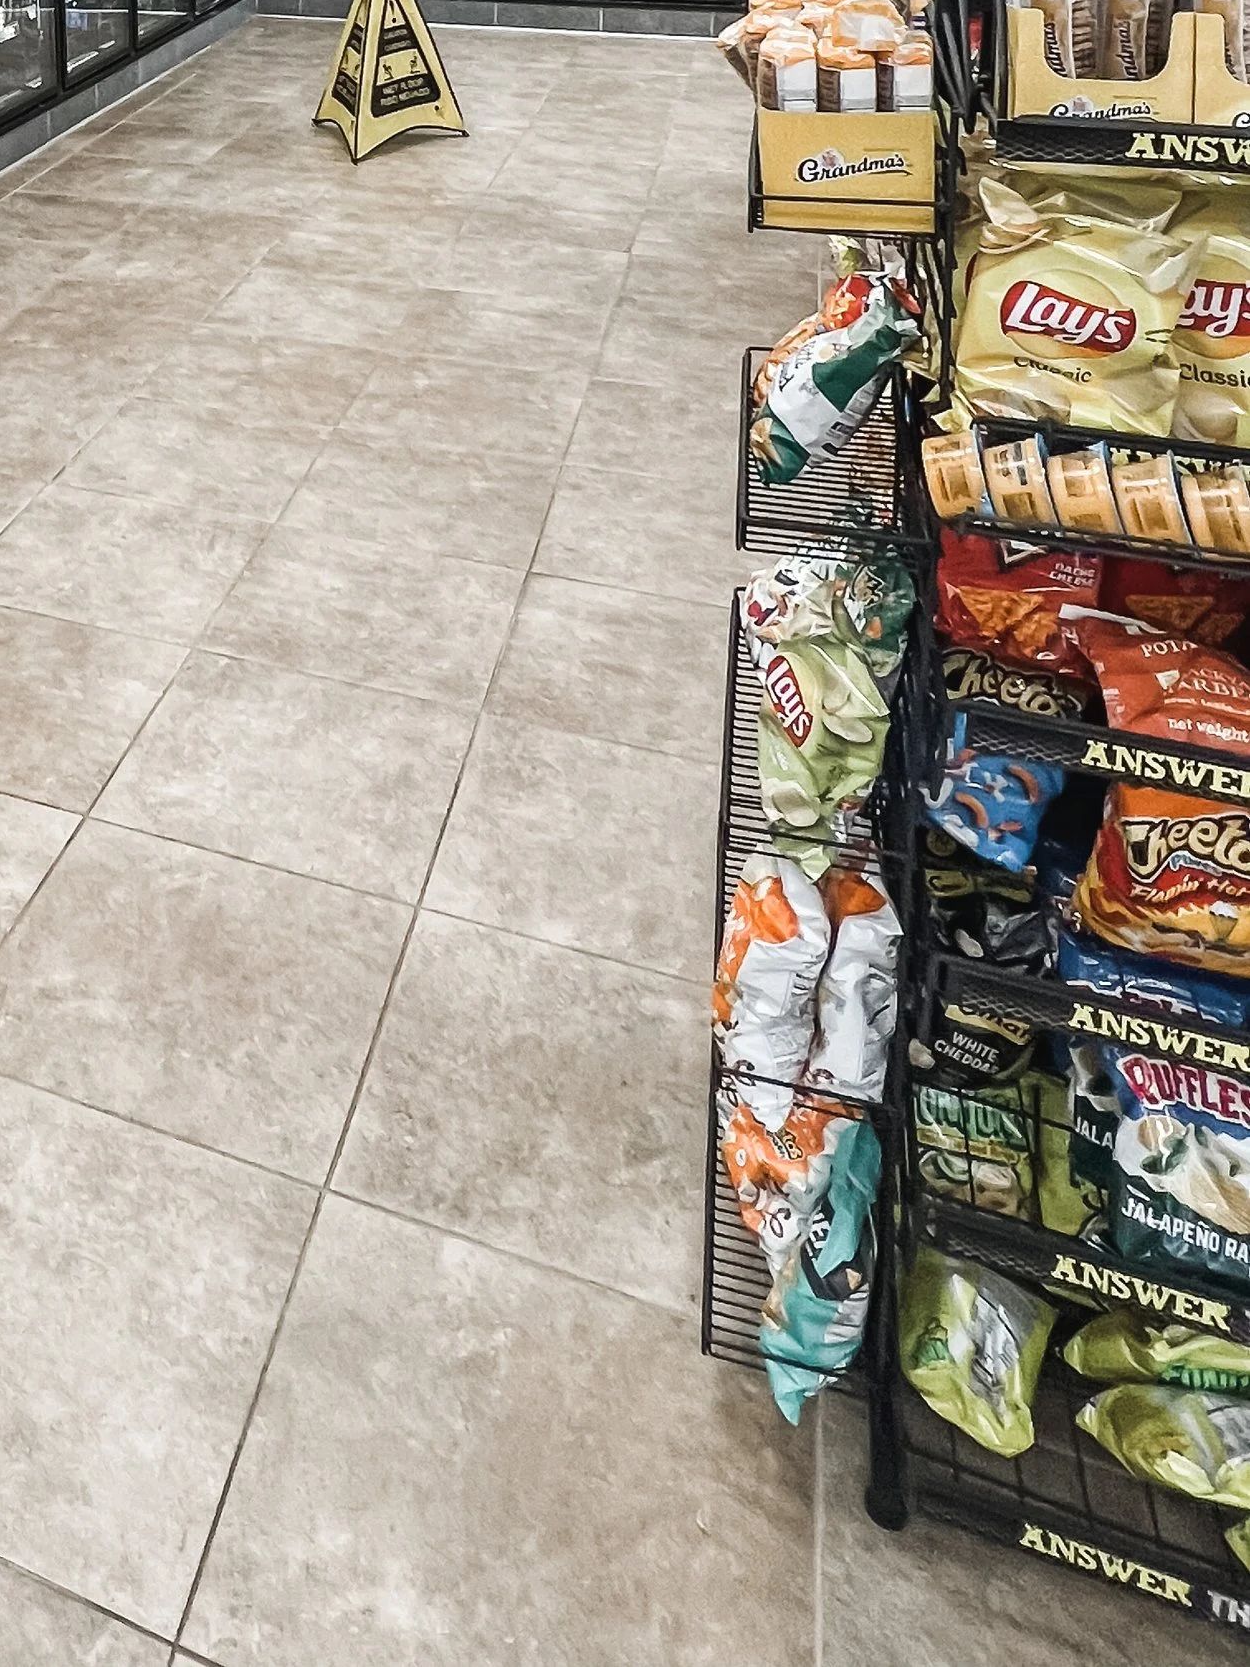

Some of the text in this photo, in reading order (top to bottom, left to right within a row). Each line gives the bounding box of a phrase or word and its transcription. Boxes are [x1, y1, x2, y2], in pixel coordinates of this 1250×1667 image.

[797, 154, 905, 183] Grandma's
[1005, 283, 1131, 345] Lay's
[766, 660, 811, 738] Lay's
[1167, 719, 1250, 743] net weight
[952, 1031, 999, 1062] WHITE
[1121, 1197, 1220, 1254] JALAPEÑO
[1051, 1254, 1231, 1332] ANSWER
[1019, 1522, 1193, 1607] ANSWER
